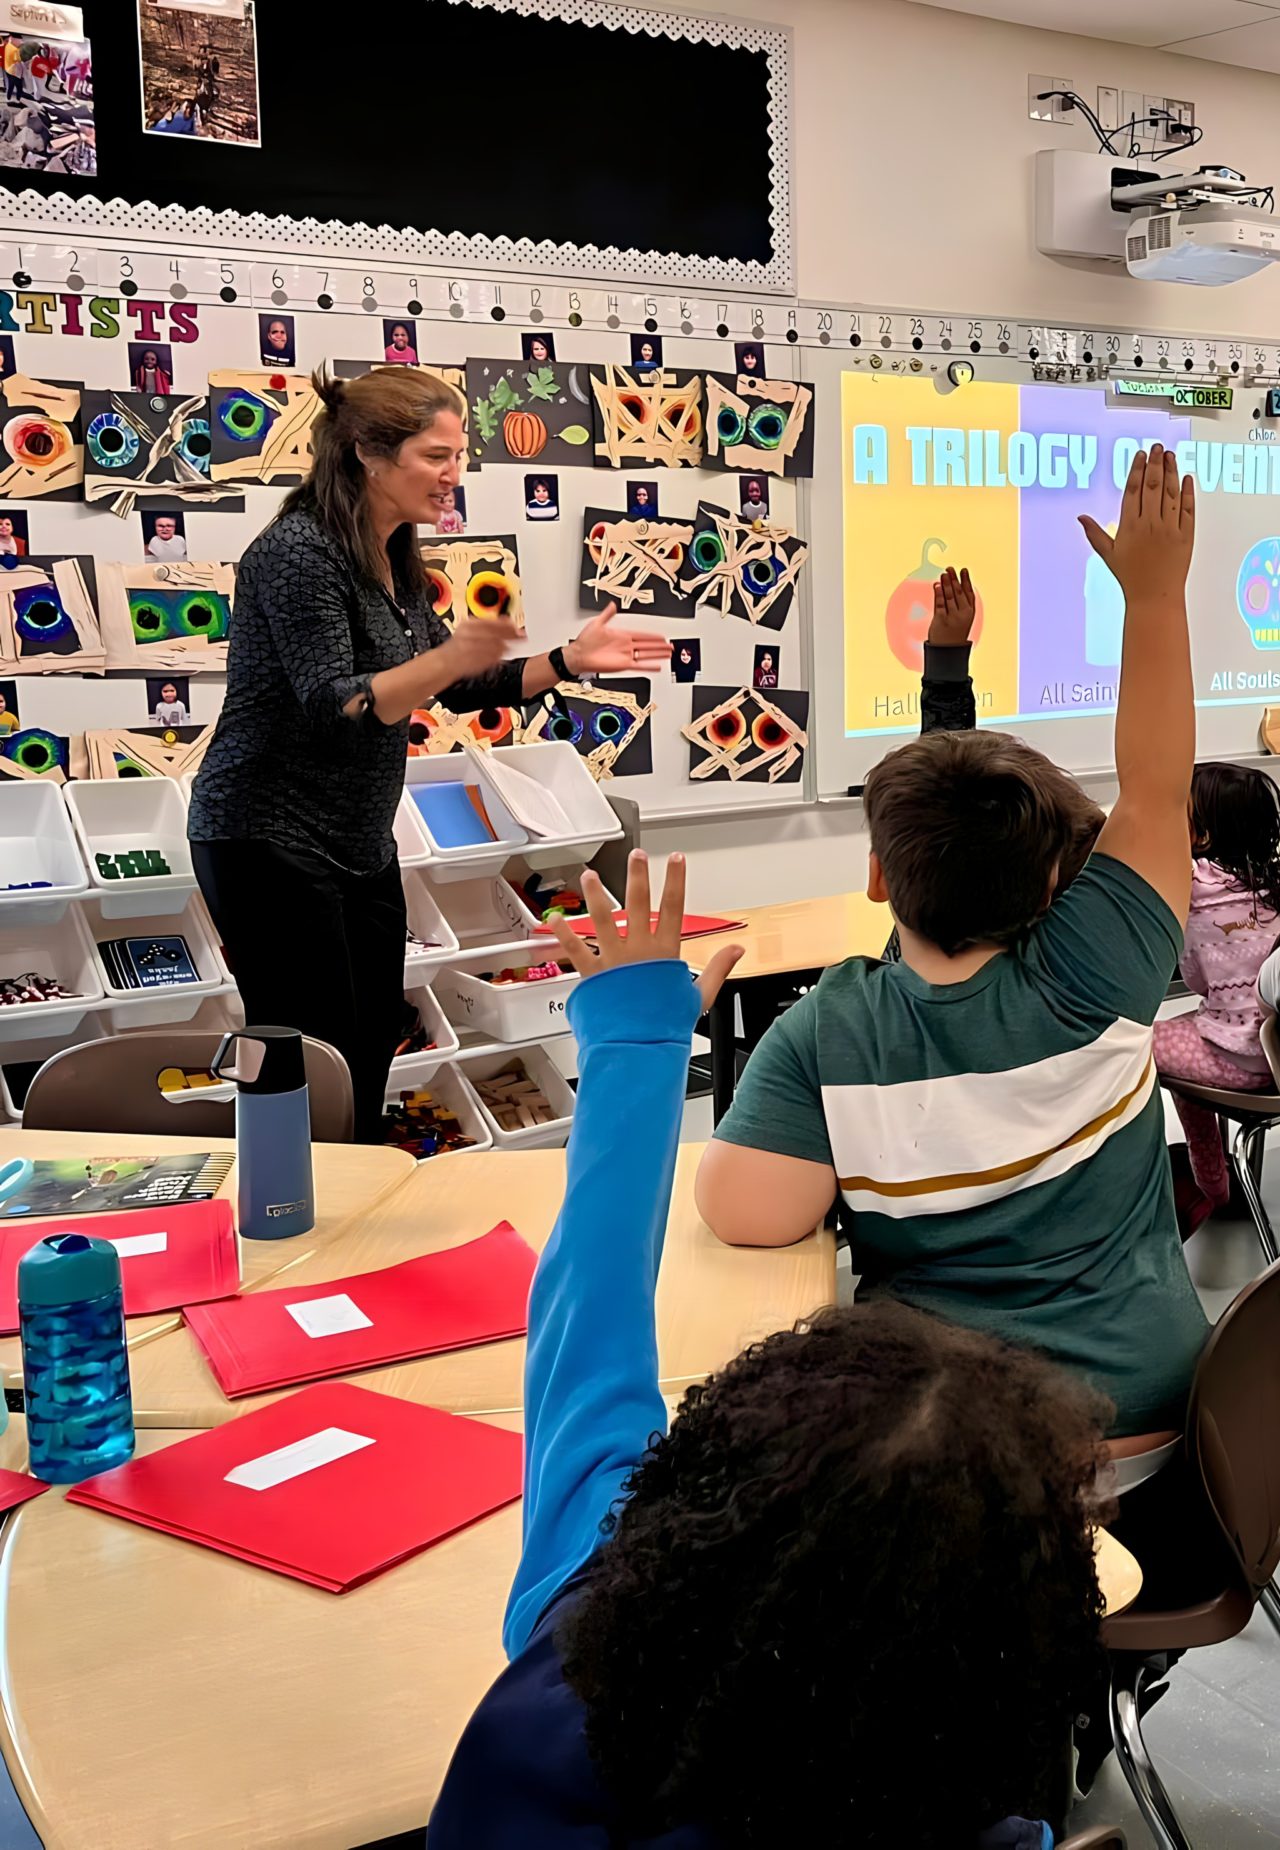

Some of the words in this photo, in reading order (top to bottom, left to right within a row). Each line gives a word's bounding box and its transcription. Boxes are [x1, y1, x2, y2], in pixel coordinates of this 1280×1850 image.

[19, 247, 22, 268] 1
[67, 251, 80, 273] 2
[120, 256, 134, 278] 3
[169, 260, 181, 280] 4
[220, 264, 235, 284] 5
[272, 269, 284, 288] 6
[317, 272, 328, 291] 7
[363, 276, 374, 296] 8
[409, 279, 418, 299] 9
[494, 286, 501, 304] 11
[531, 288, 542, 307] 12
[608, 295, 618, 312] 14
[645, 298, 657, 315] 15
[681, 301, 691, 318] 16
[717, 304, 728, 322] 17
[752, 308, 764, 325] 18
[817, 313, 832, 330] 20
[850, 315, 860, 331] 21
[879, 316, 891, 334] 22
[910, 318, 924, 336] 23
[939, 320, 952, 338] 24
[968, 322, 982, 339] 25
[998, 324, 1011, 340] 26
[1082, 333, 1094, 349] 29
[1106, 336, 1120, 351] 30
[1158, 341, 1171, 356] 32
[1182, 343, 1195, 357] 33
[1228, 344, 1242, 360] 35
[1253, 348, 1266, 362] 36
[1176, 390, 1228, 405] OCTOBER
[853, 424, 888, 484] A
[906, 426, 1098, 489] TRILOGY
[1210, 671, 1232, 690] All
[1237, 670, 1280, 689] Souls
[1040, 683, 1065, 705] All
[549, 1001, 564, 1014] Ro
